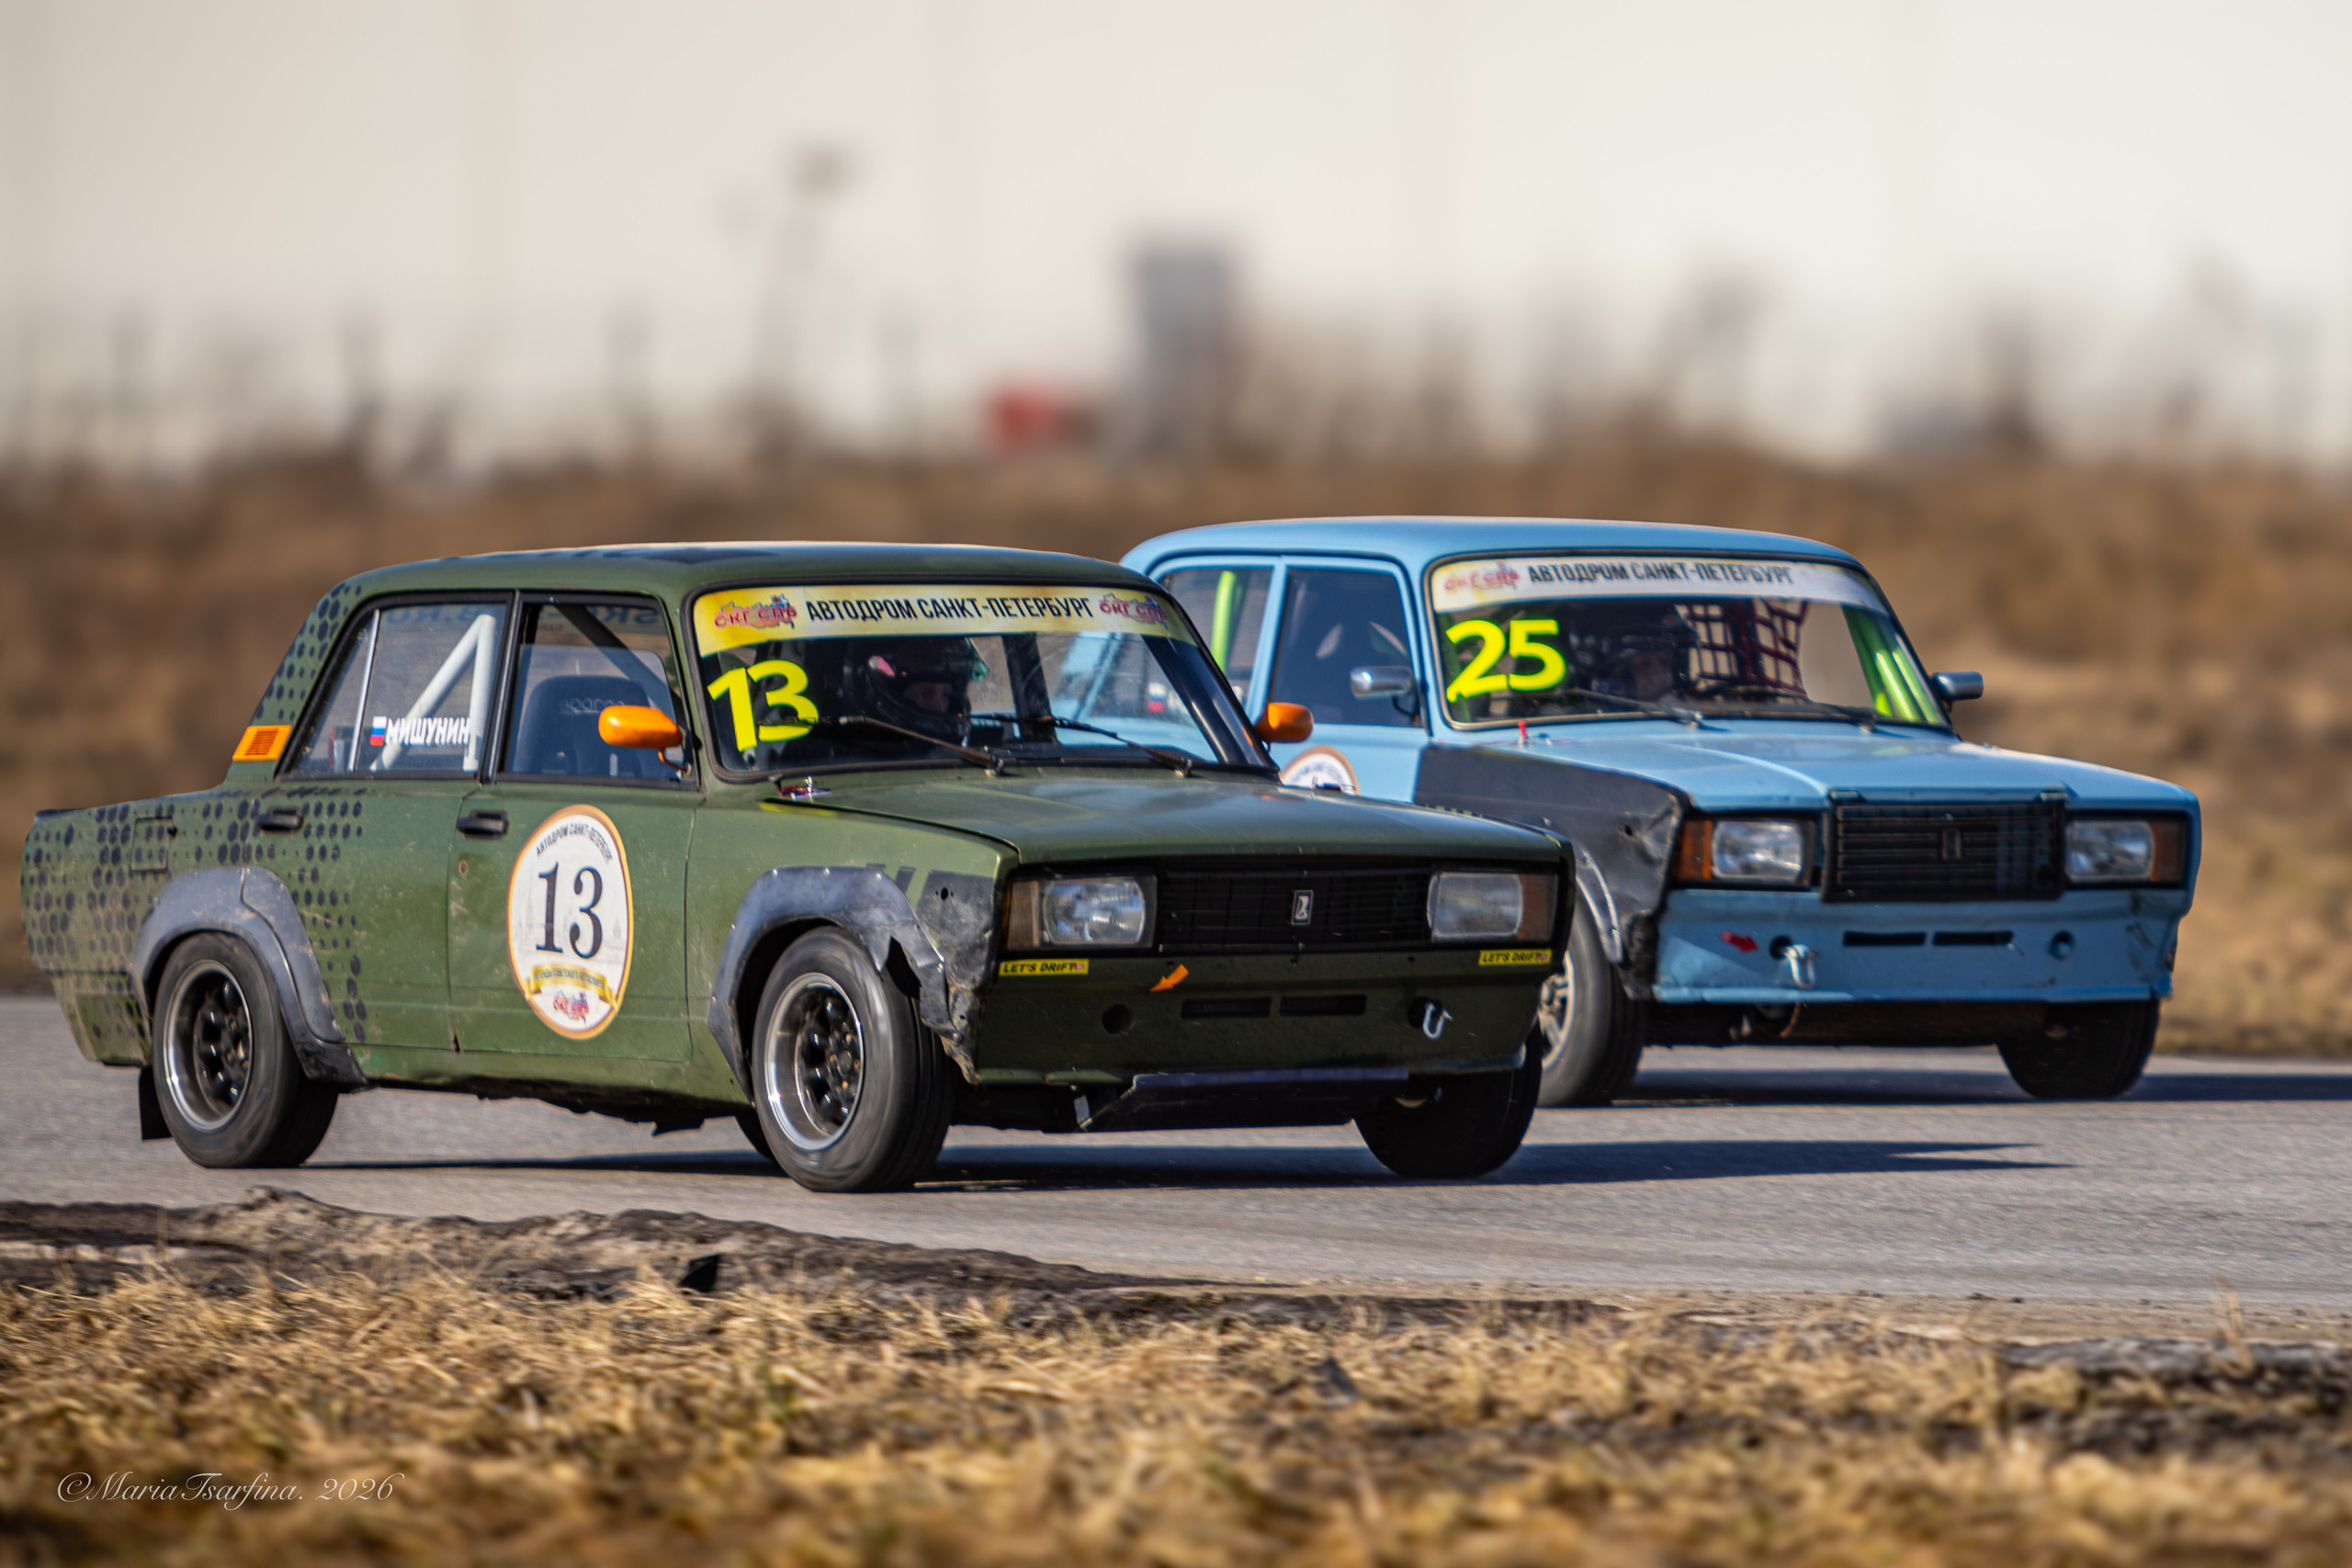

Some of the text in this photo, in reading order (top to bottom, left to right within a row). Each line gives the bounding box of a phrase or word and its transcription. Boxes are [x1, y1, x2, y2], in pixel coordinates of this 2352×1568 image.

[1527, 561, 1793, 585] АВТОДРОМ САНКТ-ПЕТЕРБУРГ
[806, 597, 1092, 621] АВТОДРОМ САНКТ-ПЕТЕРБУРГ
[1445, 619, 1566, 703] 25
[707, 660, 820, 752] 13
[386, 717, 469, 746] МИШУНИН
[536, 862, 603, 959] 13
[1003, 962, 1076, 973] LET'S DRIFT
